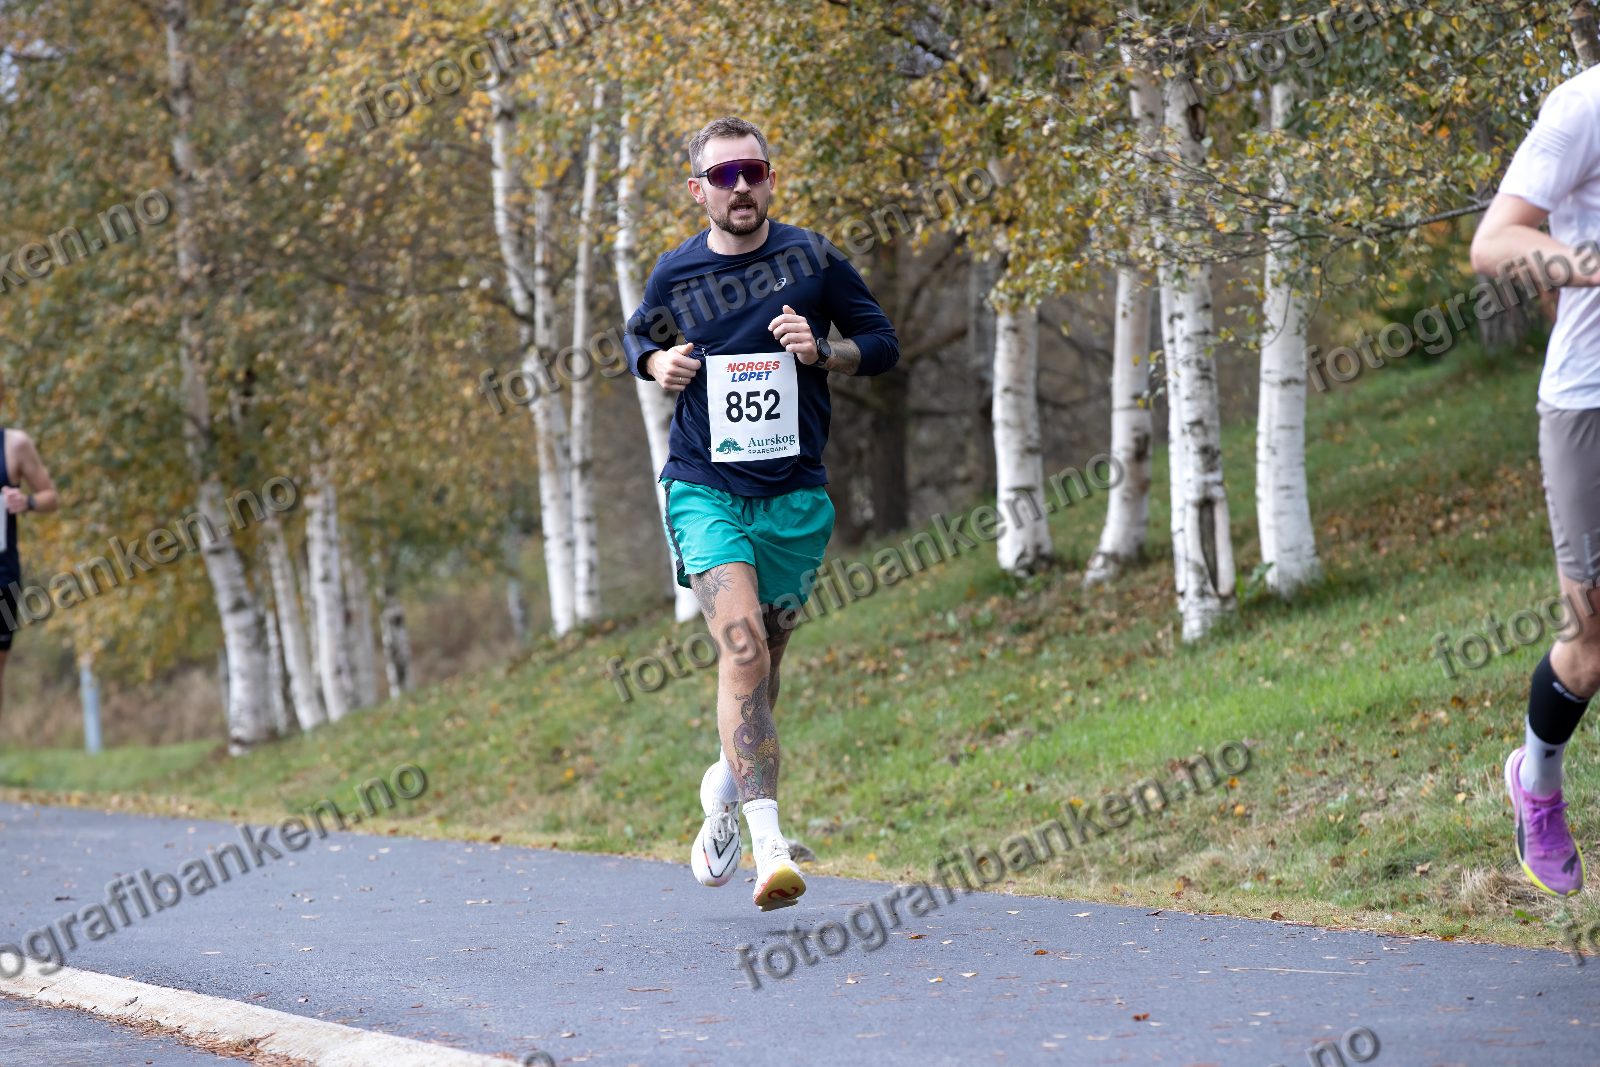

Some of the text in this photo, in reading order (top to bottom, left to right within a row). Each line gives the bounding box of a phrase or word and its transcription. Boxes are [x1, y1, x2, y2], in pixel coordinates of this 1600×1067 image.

[727, 360, 780, 372] NORGES
[731, 371, 772, 382] LØPET
[726, 388, 781, 423] 852
[748, 434, 796, 448] Aurskog
[748, 446, 788, 454] SPAREBANK
